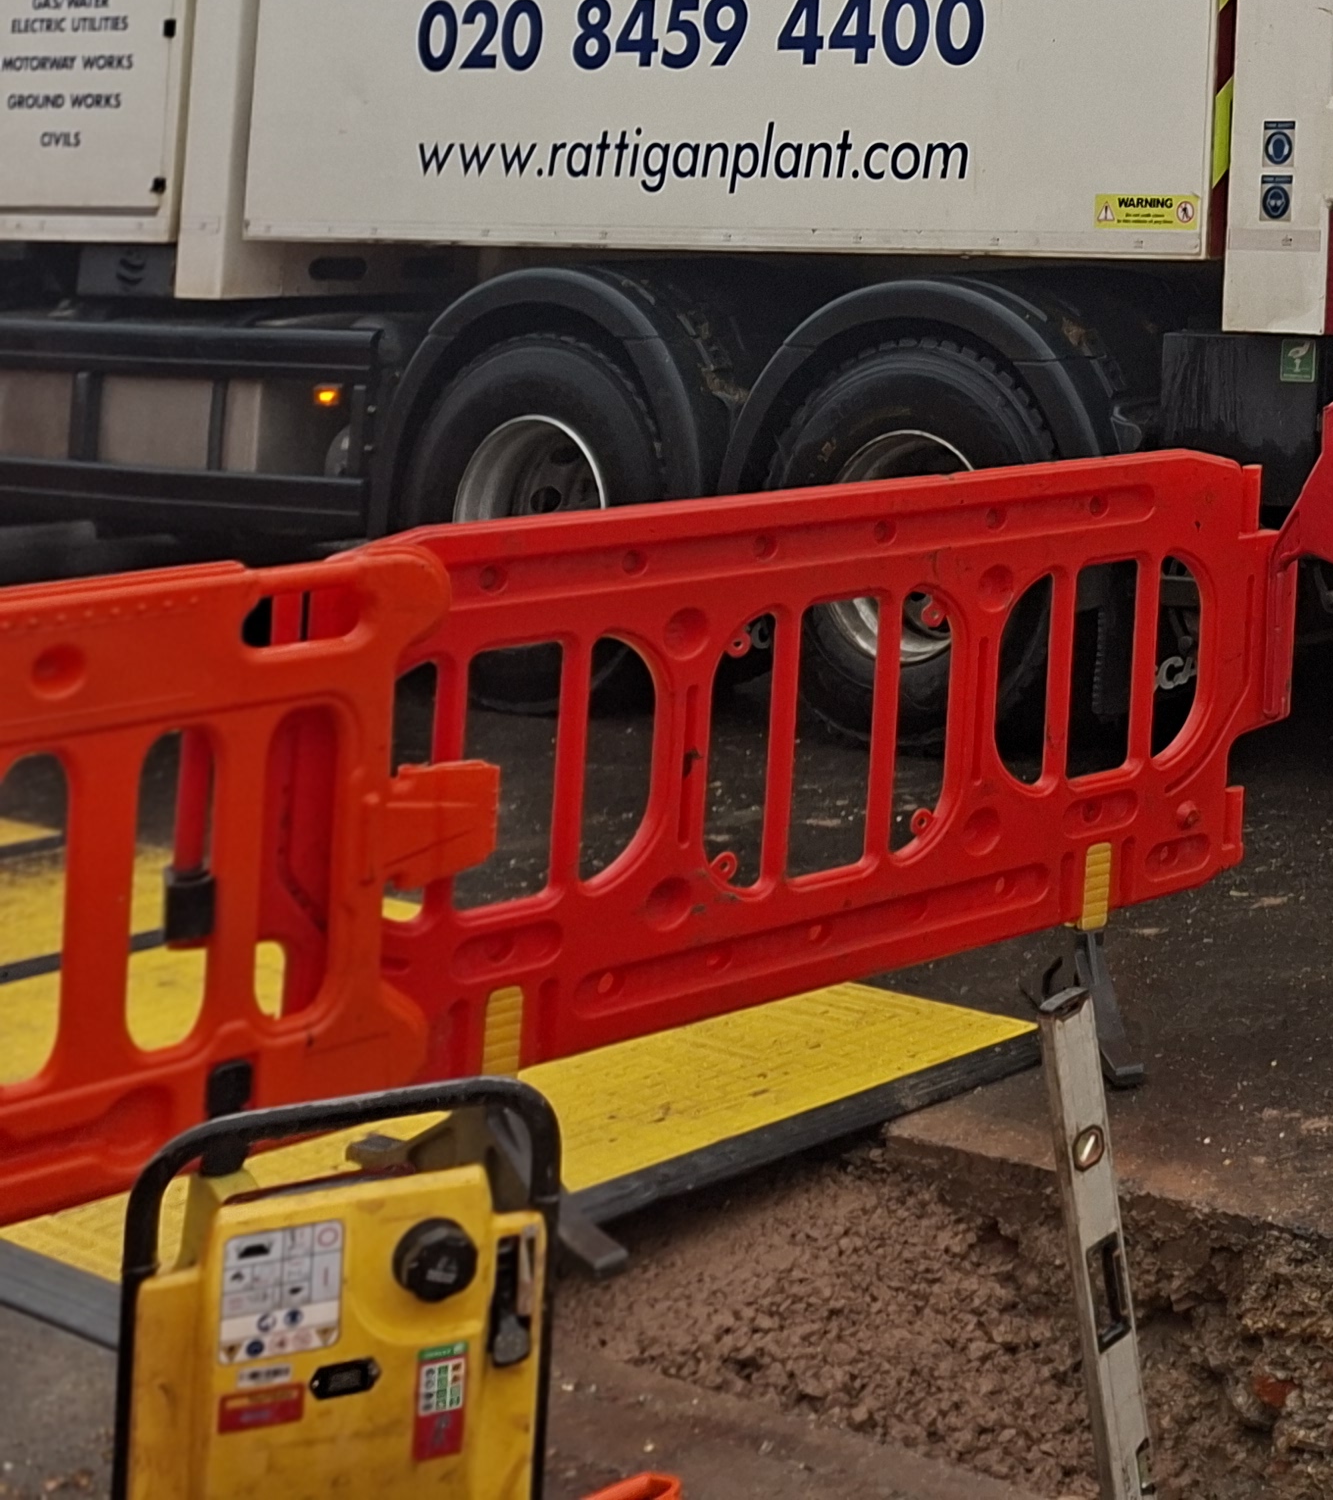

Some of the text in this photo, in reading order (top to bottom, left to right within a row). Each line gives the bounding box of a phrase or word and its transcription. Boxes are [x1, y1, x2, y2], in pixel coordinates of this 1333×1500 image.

[11, 15, 129, 33] ELECTRIC UTILITIES
[2, 53, 133, 71] MOTORWAY WORKS
[7, 92, 121, 110] GROUND WORKS
[40, 131, 81, 147] CIVILS
[417, 120, 970, 194] www.rattiganplant.com
[1117, 197, 1174, 209] WARNING
